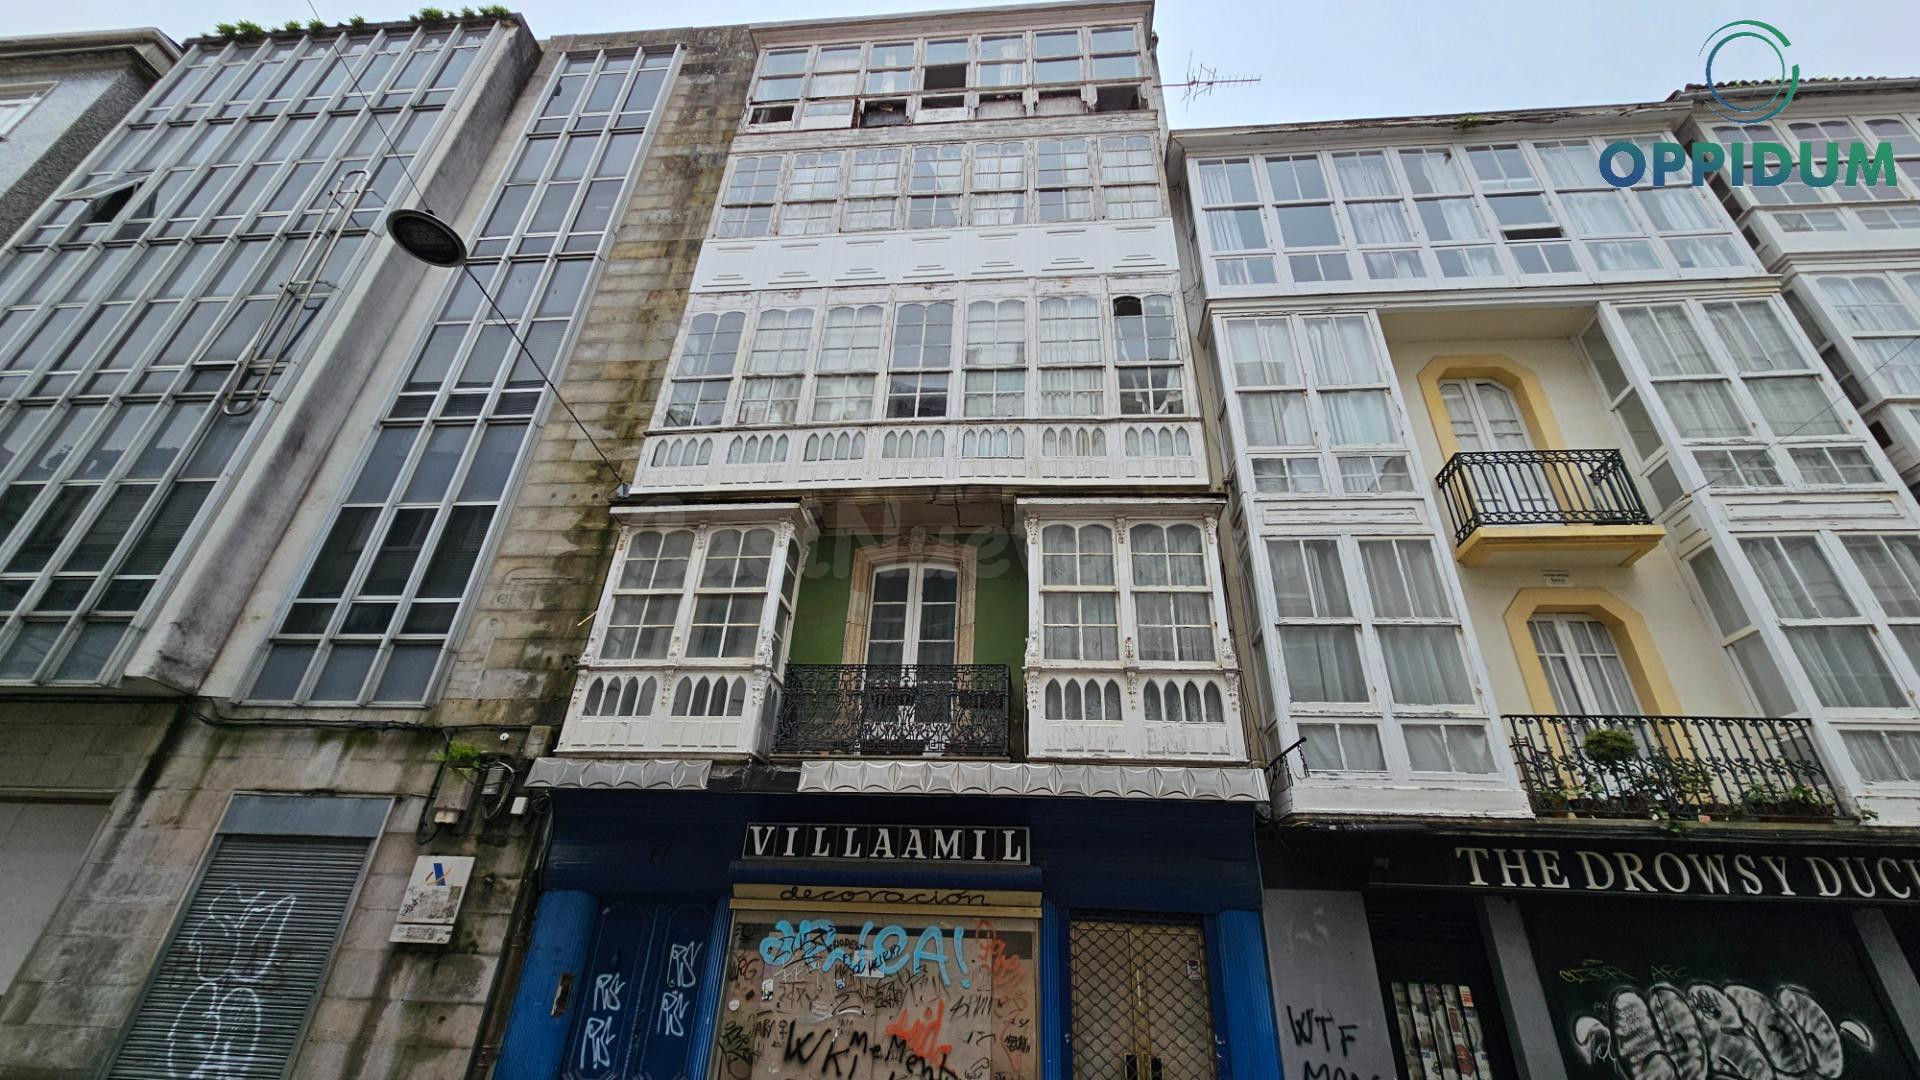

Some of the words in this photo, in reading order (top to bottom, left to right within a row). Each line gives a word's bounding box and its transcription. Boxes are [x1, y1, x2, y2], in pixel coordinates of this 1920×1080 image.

[750, 826, 1022, 861] VILLAAMIL
[1455, 847, 1571, 889] THE
[1575, 850, 1797, 896] DROWSY
[779, 886, 991, 906] decoración
[1286, 1005, 1359, 1057] WTF
